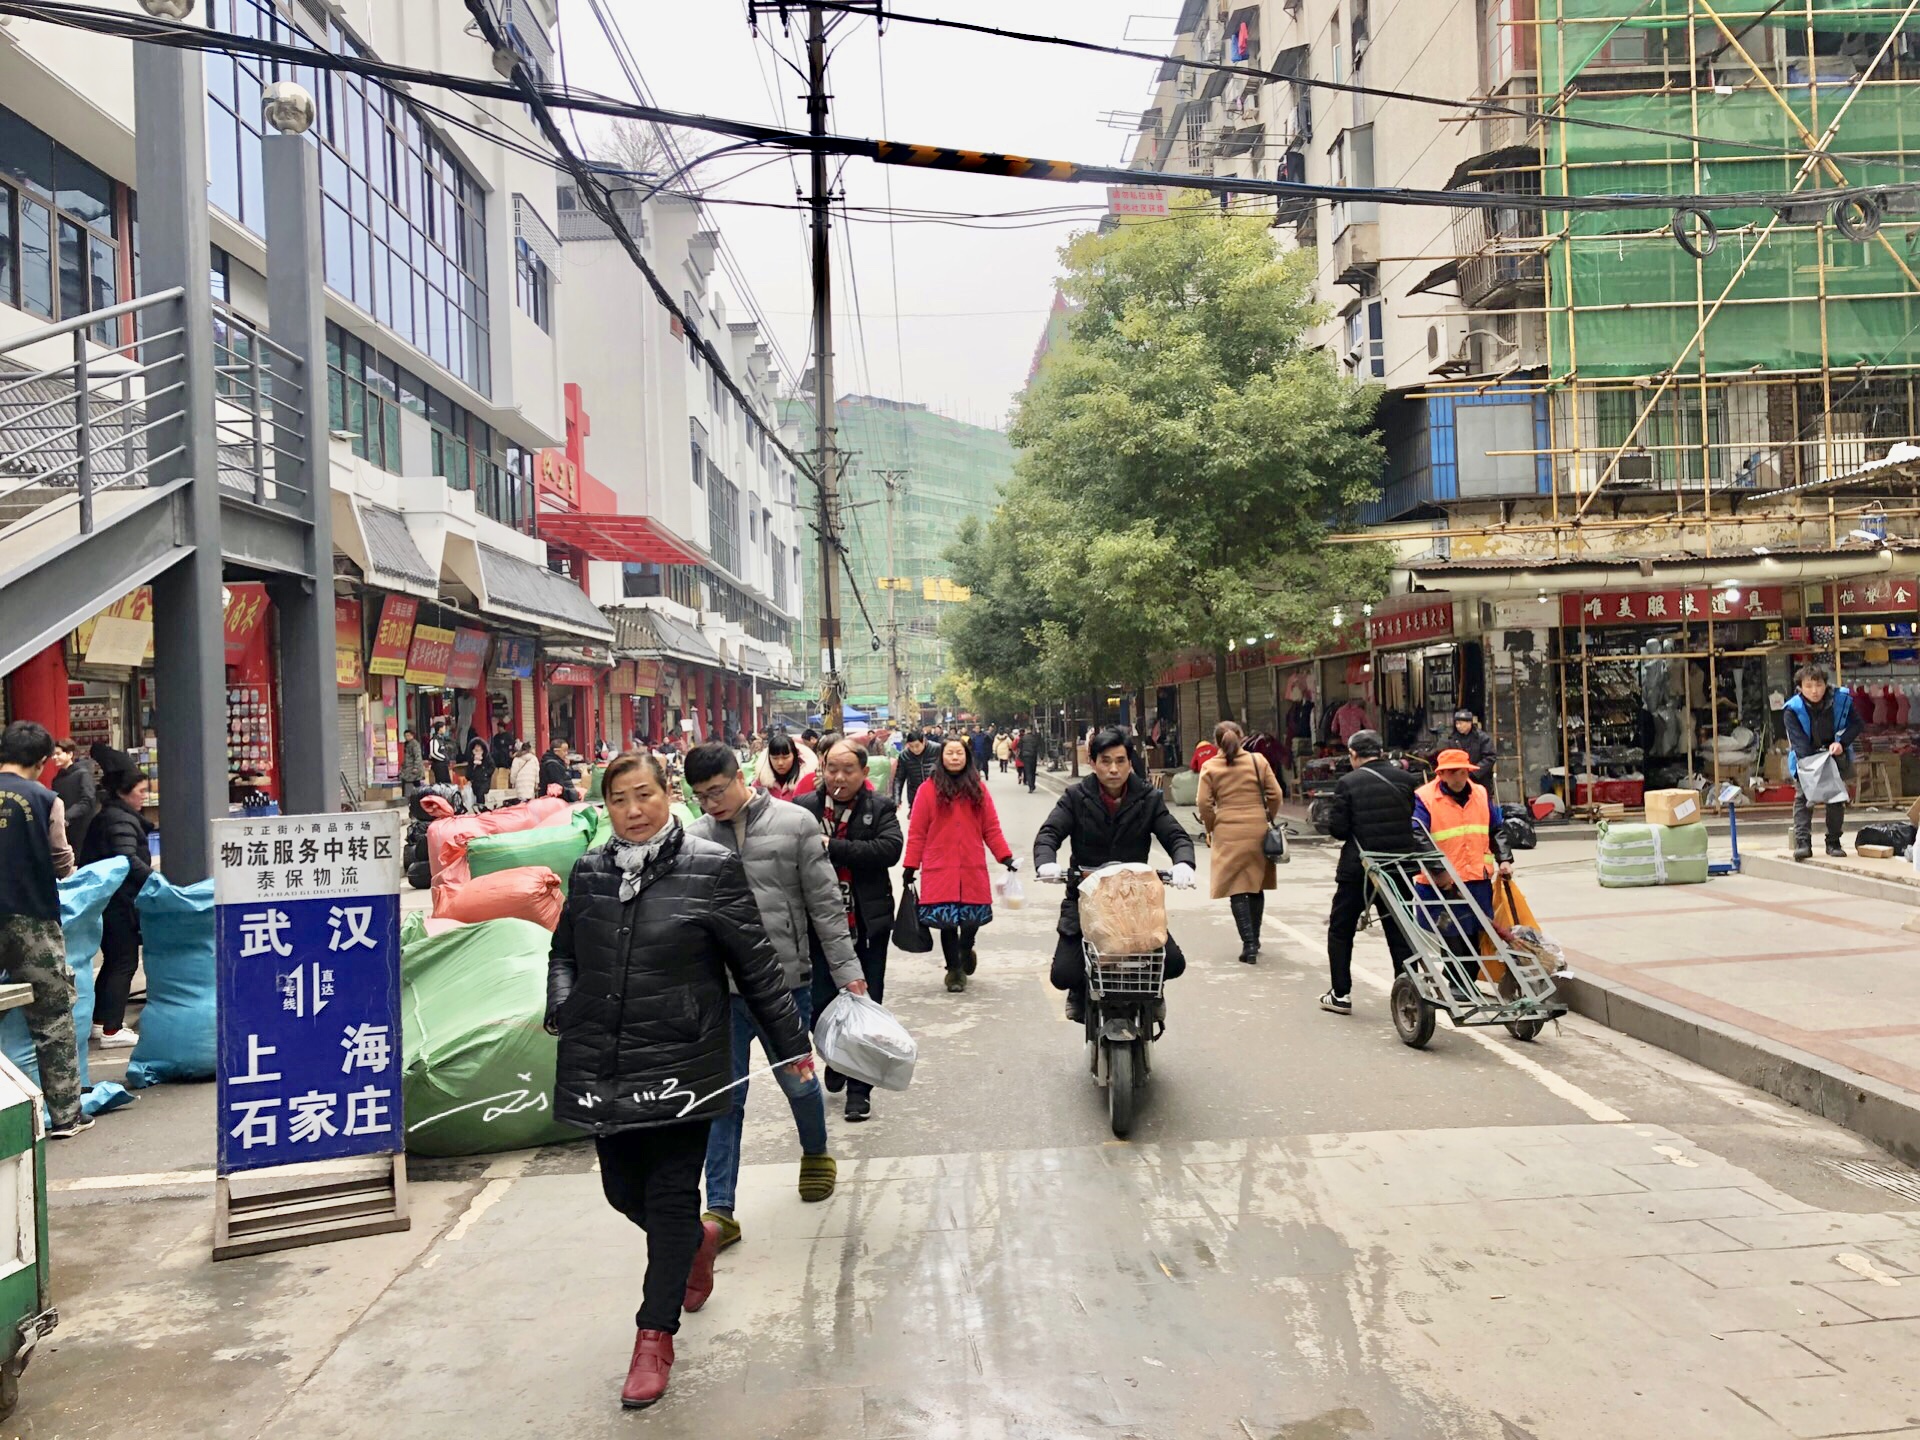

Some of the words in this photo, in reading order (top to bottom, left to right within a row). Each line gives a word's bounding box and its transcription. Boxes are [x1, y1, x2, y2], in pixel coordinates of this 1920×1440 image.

[243, 821, 371, 836] 汉正街小商品市场
[220, 835, 393, 868] 物流服务中转区
[257, 867, 359, 890] 泰保物流
[239, 905, 378, 957] 武汉
[282, 978, 297, 1011] 专线
[320, 969, 335, 996] 直达
[228, 1023, 391, 1085] 上海
[230, 1085, 392, 1149] 石家庄
